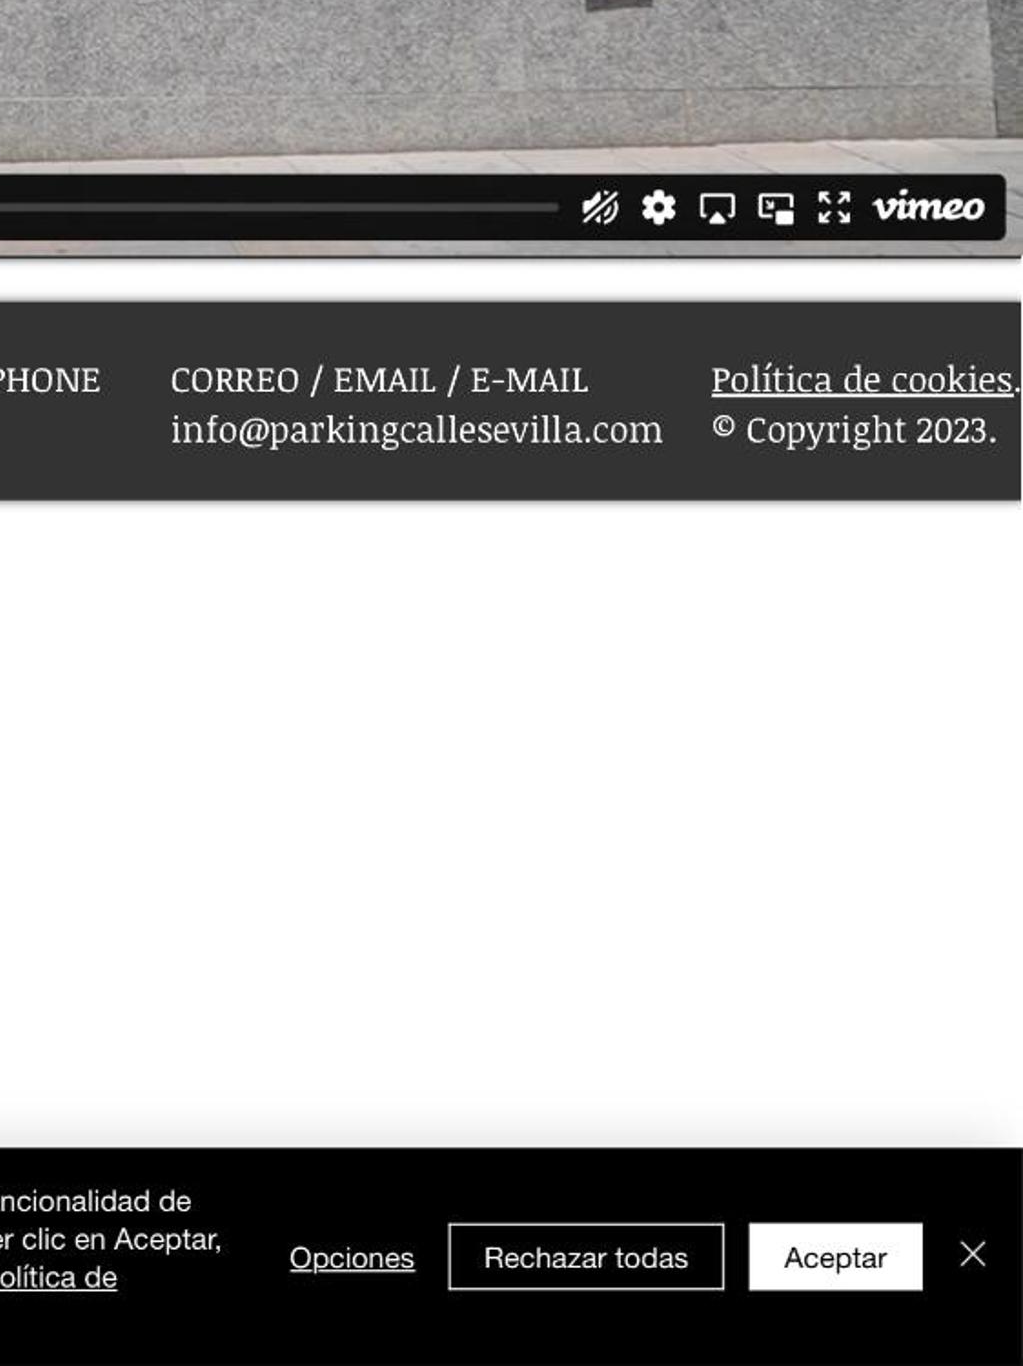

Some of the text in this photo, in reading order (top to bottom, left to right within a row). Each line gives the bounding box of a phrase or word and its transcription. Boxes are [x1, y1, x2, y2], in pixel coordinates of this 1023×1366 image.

[872, 188, 985, 220] vimeo
[172, 368, 298, 393] CORREO
[334, 368, 436, 392] EMAIL
[471, 368, 588, 392] E-MAIL
[712, 362, 1022, 392] Política de cookies.
[172, 415, 663, 451] info@parkingcallesevilla.com
[713, 415, 996, 451] © Copyright 2023.
[159, 1189, 191, 1212] de
[22, 1227, 66, 1250] clic
[75, 1233, 105, 1250] en
[114, 1227, 220, 1255] Aceptar,
[290, 1246, 414, 1273] Opciones
[485, 1247, 688, 1269] Rechazar todas
[784, 1247, 888, 1274] Aceptar
[85, 1266, 118, 1288] de
